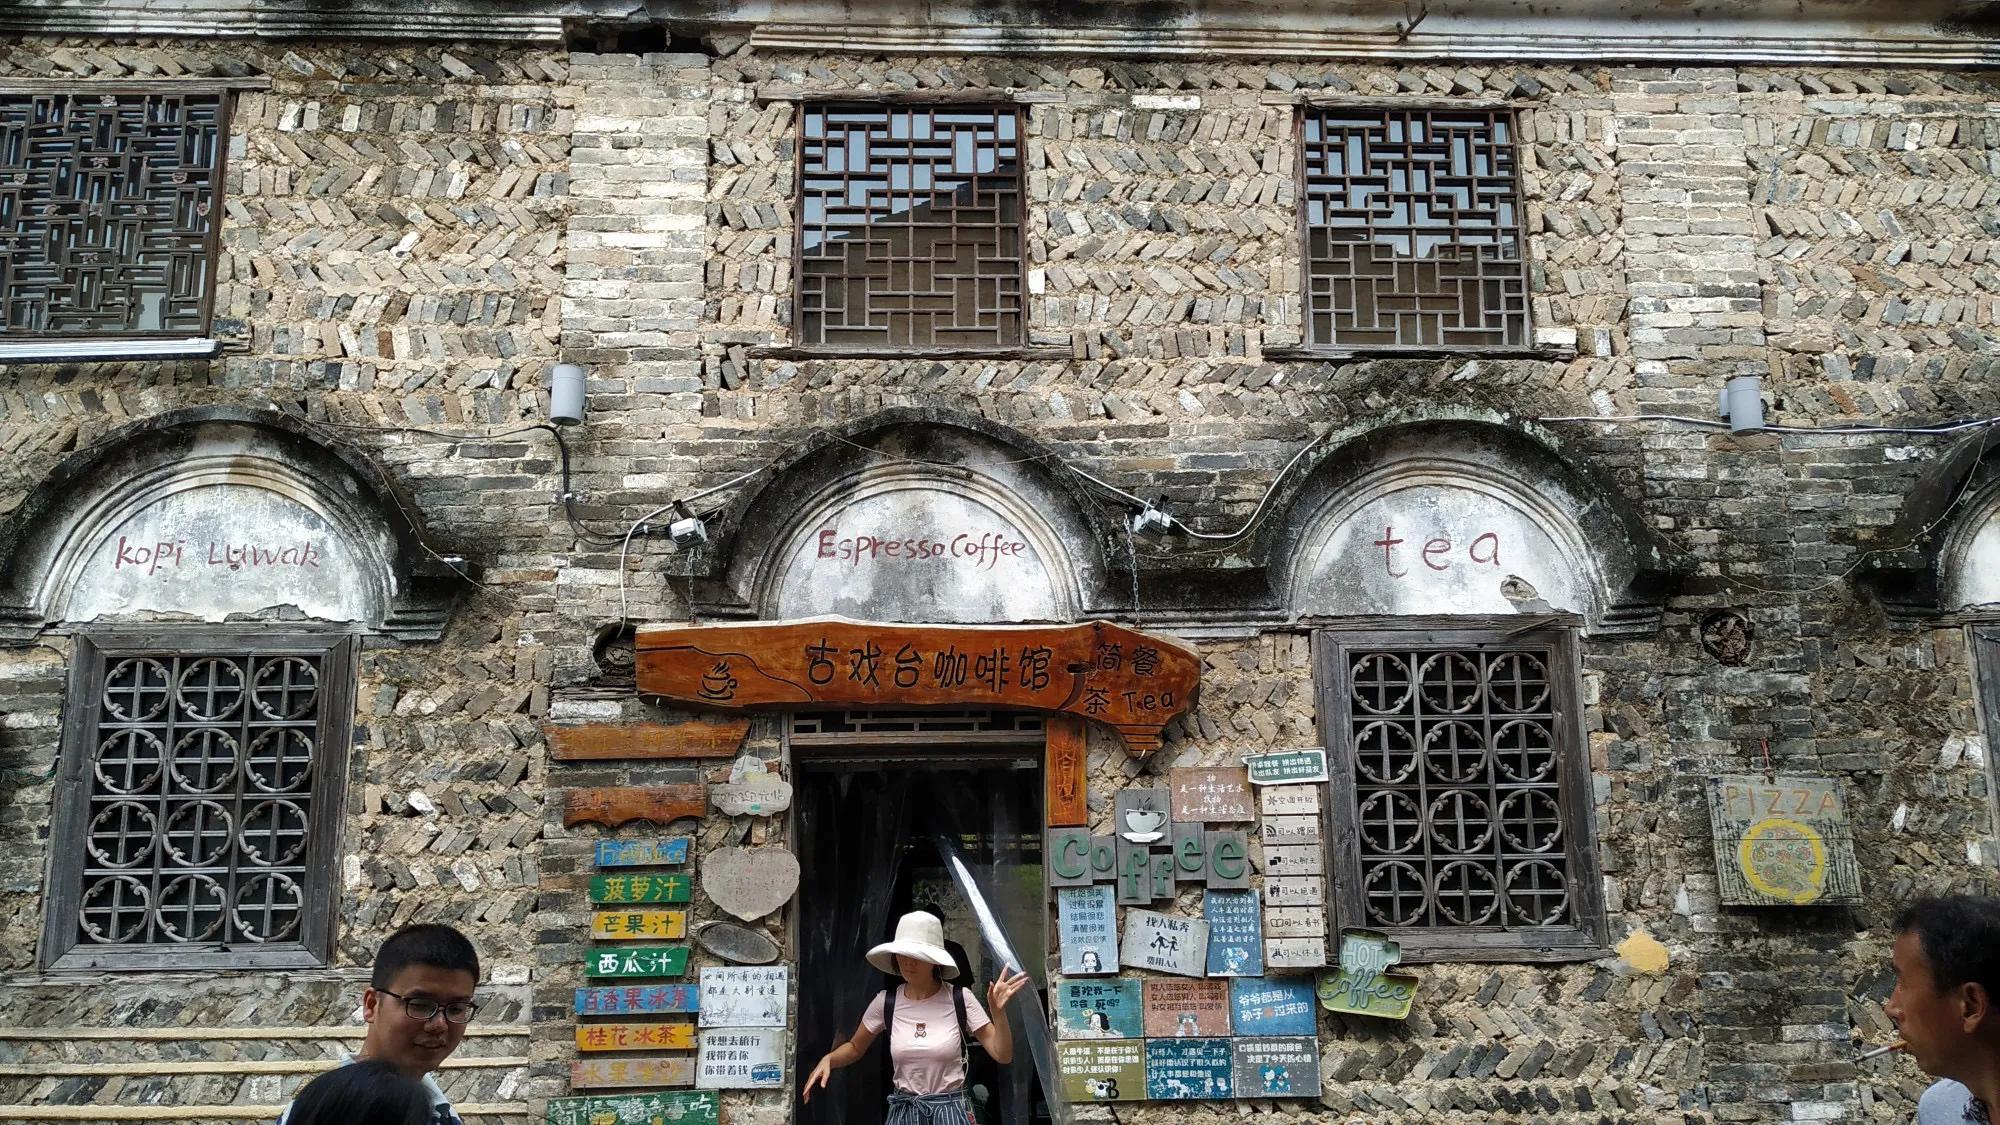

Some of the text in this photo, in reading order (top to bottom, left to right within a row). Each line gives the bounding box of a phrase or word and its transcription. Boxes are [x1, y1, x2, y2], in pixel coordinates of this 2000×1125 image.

[817, 529, 1025, 570] Espresso Coffee
[1374, 526, 1500, 578] tea
[806, 638, 1053, 693] 古戏台咖啡馆
[1097, 642, 1158, 677] 简餐
[1083, 687, 1174, 715] 茶 Tea
[1725, 785, 1843, 817] PIZZA
[1053, 833, 1244, 899] Coffee
[1281, 856, 1316, 867] 可以聊天
[604, 876, 681, 901] 菠萝汁
[603, 914, 674, 935] 芒果汁
[1146, 915, 1190, 933] 找人私奔
[598, 950, 672, 974] 西瓜汁
[1342, 942, 1384, 968] HOT
[1069, 985, 1123, 998] 喜欢我一下
[1238, 985, 1296, 1006] 爷爷都是从
[586, 1025, 677, 1047] 桂花冰茶
[705, 1035, 761, 1047] 我想去旅行
[705, 1050, 749, 1061] 我带着你
[704, 1064, 749, 1076] 你带着钱
